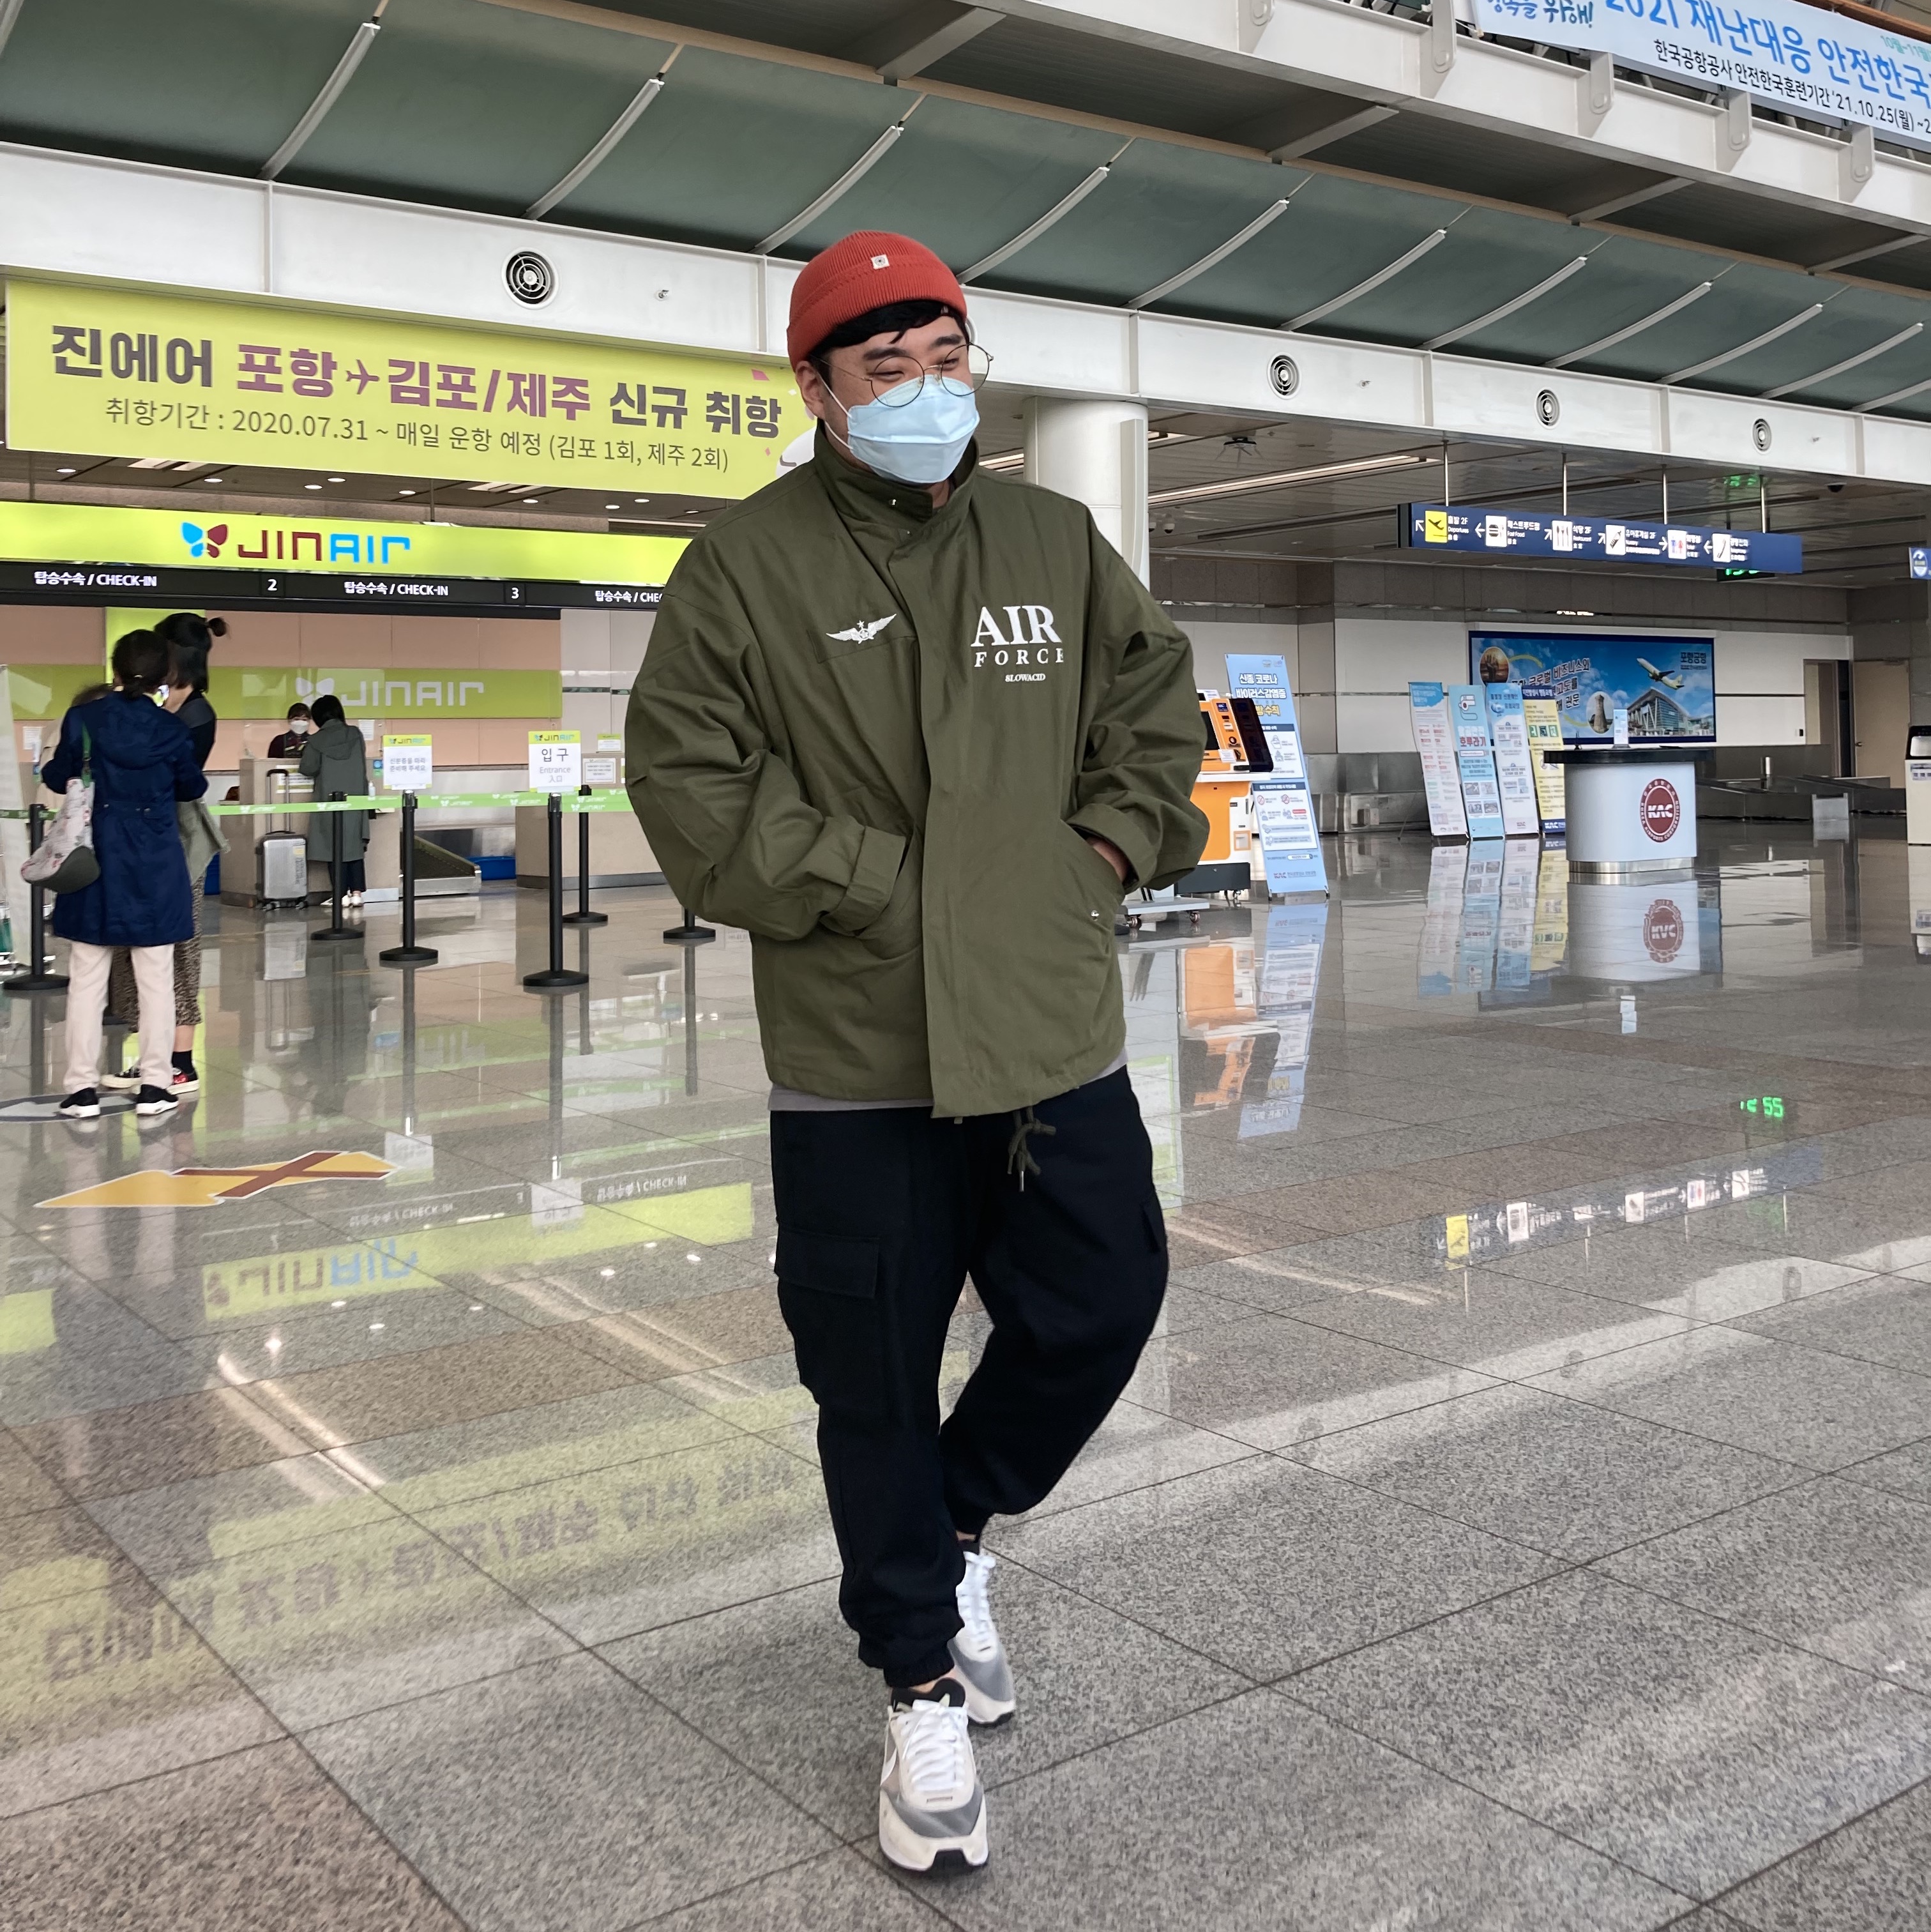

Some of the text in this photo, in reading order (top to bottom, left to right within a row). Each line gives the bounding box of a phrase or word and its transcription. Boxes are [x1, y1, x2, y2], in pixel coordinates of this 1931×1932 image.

[1653, 38, 1732, 81] 한국공항공사
[1685, 0, 1811, 75] 재난대응
[1817, 37, 1931, 110] 안전한국
[52, 325, 782, 439] 진에어 포항 김포/제주 신규 취항
[105, 397, 209, 430] 취항기간
[232, 409, 368, 441] 2020.07.31
[397, 422, 440, 448] 매일
[449, 426, 492, 452] 운항
[501, 430, 541, 457] 예정
[549, 434, 597, 460] (김포
[604, 441, 642, 467] 1회,
[647, 442, 686, 468] 제주
[691, 446, 729, 473] 2회)
[1460, 517, 1468, 525] 2F
[34, 571, 86, 586] 탑승수속
[96, 574, 157, 587] CHECK-IN
[267, 579, 278, 591] 2
[344, 581, 388, 595] 탑승수속
[397, 584, 448, 596] CHECK-IN
[511, 587, 519, 599] 3
[595, 590, 632, 603] 탑승수속
[640, 592, 663, 603] CHE
[971, 605, 1063, 647] AIR
[1553, 658, 1591, 680] 비즈니스와
[1004, 673, 1046, 682] SLOWACID
[1239, 673, 1278, 685] 신종 코로나
[1235, 687, 1287, 699] 바이러스감염증
[1565, 693, 1580, 710] 관문
[1265, 704, 1281, 716] 수칙
[1459, 736, 1487, 747] 호루라기
[549, 775, 563, 783] 入口
[1647, 803, 1673, 819] KAC
